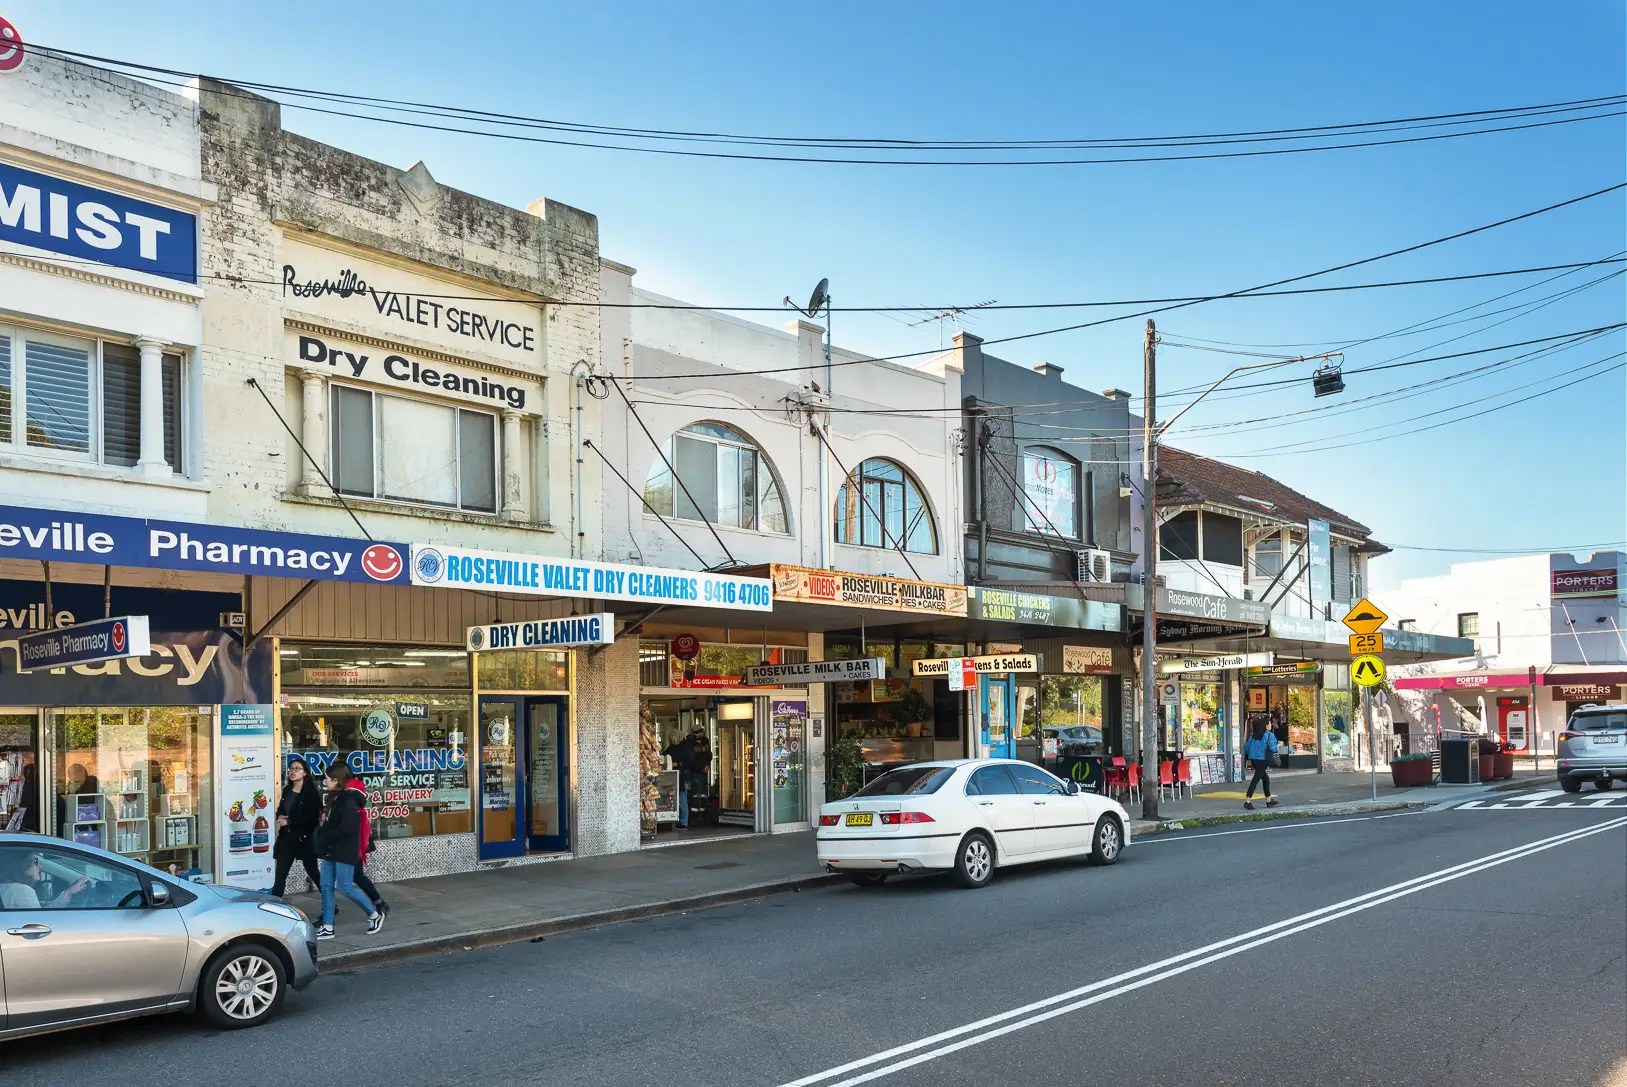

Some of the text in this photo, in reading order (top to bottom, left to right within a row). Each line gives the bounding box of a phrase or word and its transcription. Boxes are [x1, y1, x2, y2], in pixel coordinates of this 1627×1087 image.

[283, 264, 534, 351] Roseville VALET SERVICE
[299, 335, 525, 409] Dry Cleaning
[150, 529, 352, 575] Pharmacy
[447, 555, 769, 606] ROSEVILLE VALET DRY CLEANERS 9416 4706
[809, 577, 945, 600] VIDEOS ROSEVILLE MILKBAR
[1556, 576, 1613, 587] PORTERS
[842, 592, 946, 610] SANDWICHES PIES CAKES
[982, 590, 1051, 610] ROSEVILLE CHICKENS
[1168, 590, 1227, 619] Rosewood Café
[983, 607, 987, 617] &
[988, 606, 1015, 620] SALADS
[490, 617, 600, 648] DRY CLEANING
[1160, 626, 1187, 636] Sydney
[1189, 624, 1222, 635] Morning
[23, 632, 109, 661] Roseville Pharmacy
[1357, 635, 1376, 646] 25
[918, 661, 949, 673] Rosevill
[994, 659, 1000, 669] &
[1002, 658, 1032, 670] Salads
[1065, 648, 1110, 666] Rosewood Café
[1184, 657, 1242, 668] The Sun-Herald
[753, 660, 870, 677] ROSEVILLE MILK BAR
[1562, 686, 1611, 694] PORTERS
[400, 704, 424, 716] OPEN
[778, 702, 799, 715] Cadbury
[347, 748, 464, 774] CLEANING
[363, 775, 386, 788] DAY
[390, 774, 435, 787] SERVICE
[373, 788, 434, 802] & DELIVERY
[381, 806, 410, 818] 4706
